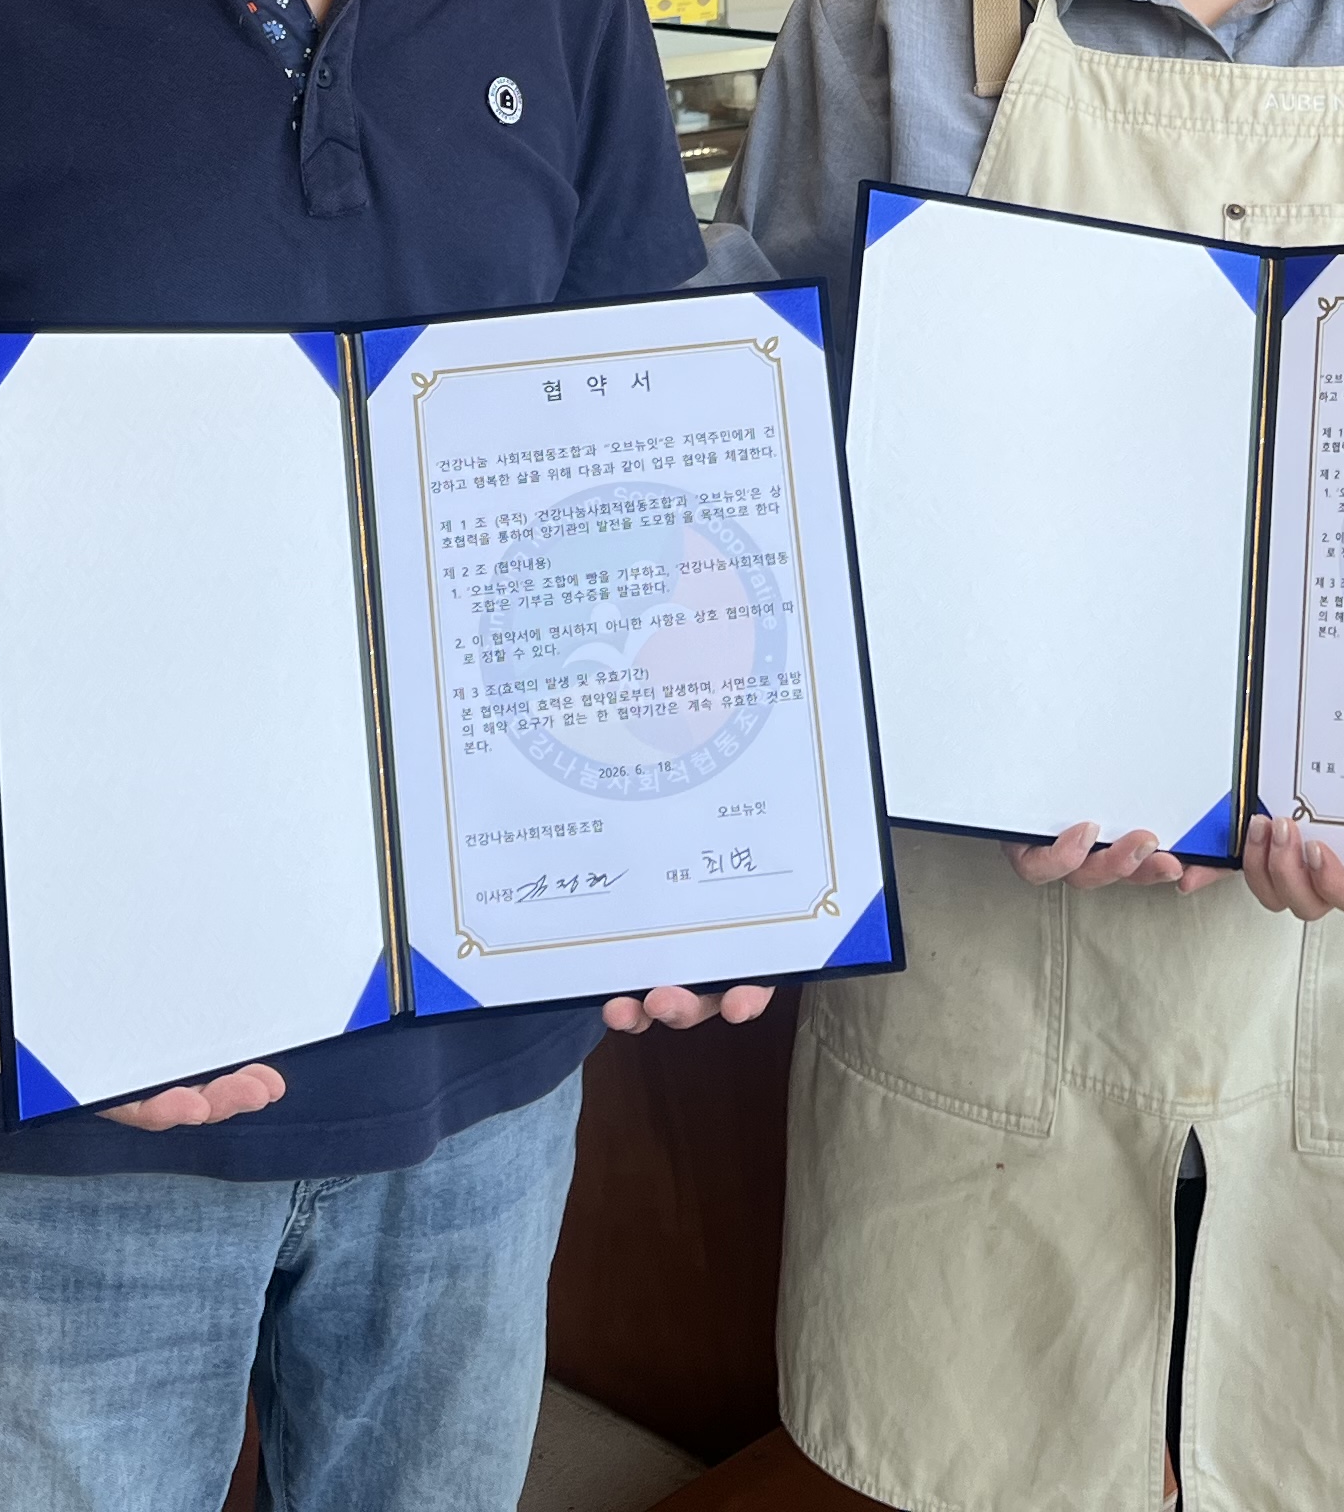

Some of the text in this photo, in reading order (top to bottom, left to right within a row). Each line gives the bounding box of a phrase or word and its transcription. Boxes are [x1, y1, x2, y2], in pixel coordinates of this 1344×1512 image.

[1263, 91, 1327, 112] AUBE
[431, 446, 776, 494] 강하고 행복한 삶을 위해 다음과 같이 업무 협약을 체결한다.
[443, 557, 551, 580] 제 2 조 (협약내용)
[1315, 577, 1324, 588] 제
[1329, 578, 1335, 588] 3
[455, 601, 794, 649] 2. 이 협약서에 명시하지 아니한 사항은 상호 협의하여 따
[718, 801, 766, 818] 오브뉴잇
[465, 819, 604, 847] 건강나눔사회적협동조합
[667, 869, 691, 881] 대표
[477, 890, 513, 904] 이사장
